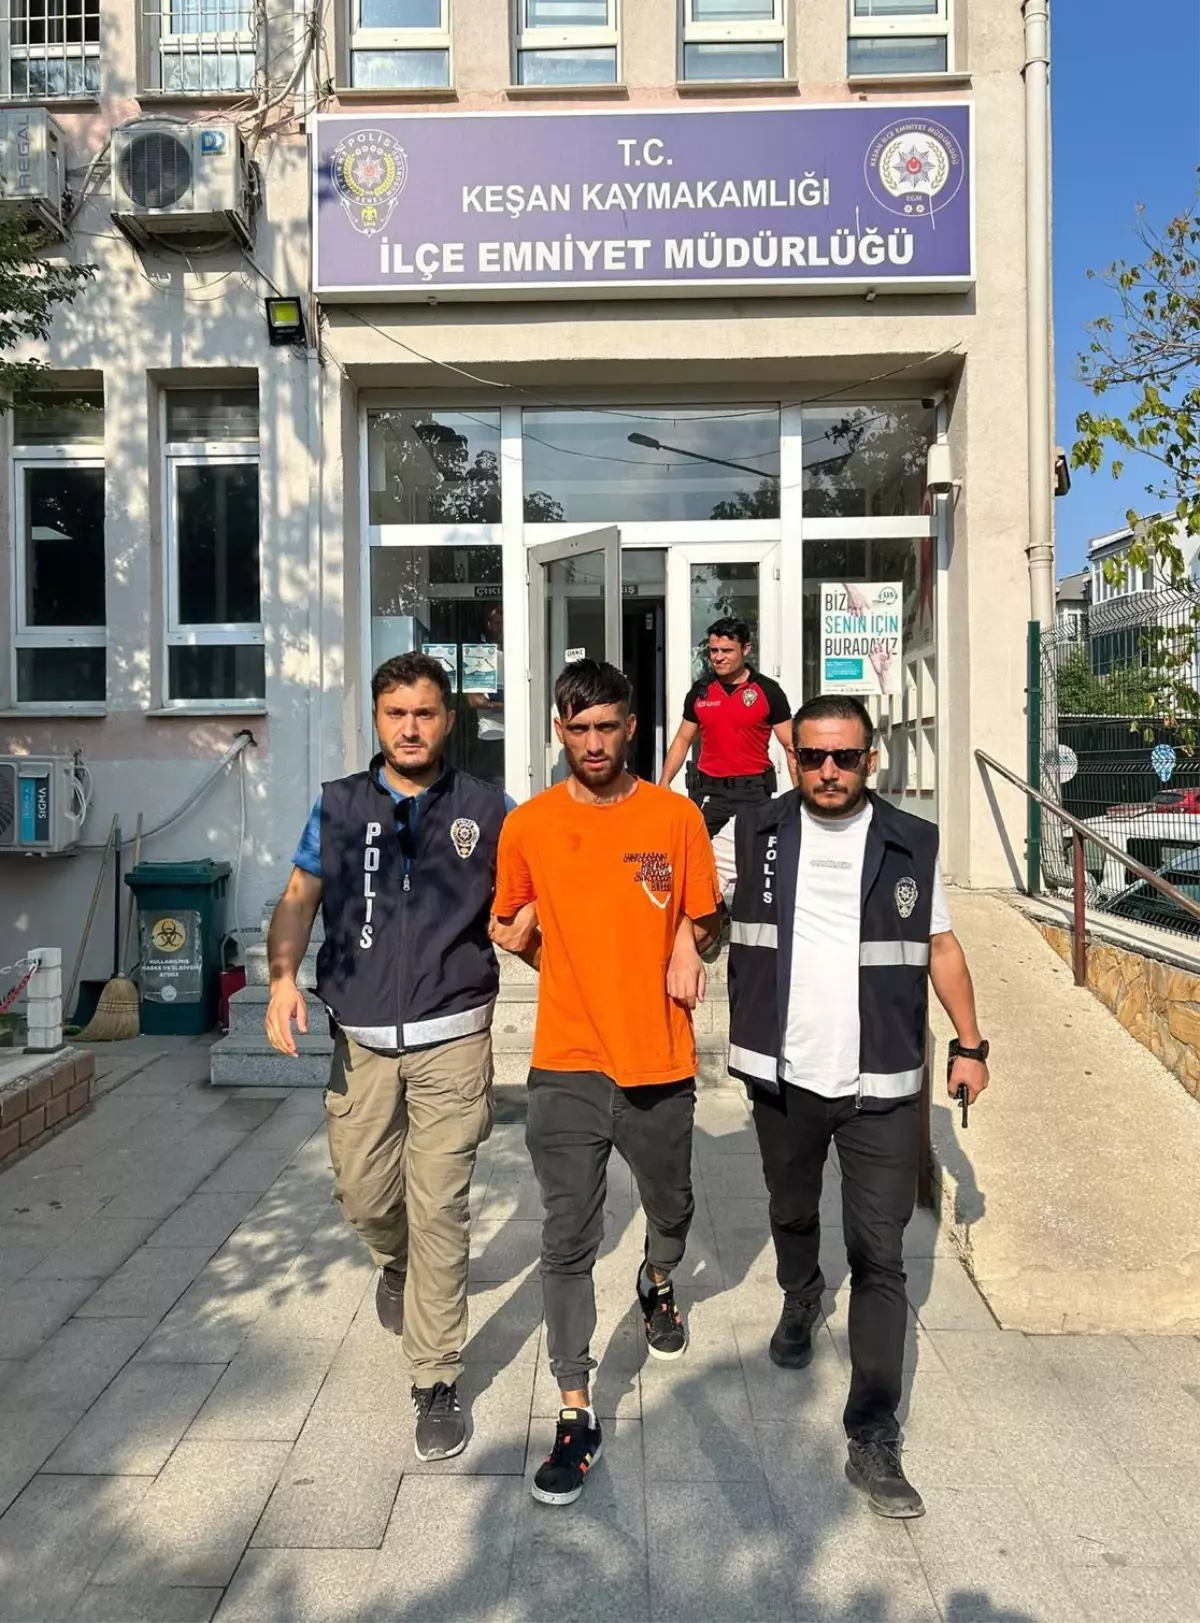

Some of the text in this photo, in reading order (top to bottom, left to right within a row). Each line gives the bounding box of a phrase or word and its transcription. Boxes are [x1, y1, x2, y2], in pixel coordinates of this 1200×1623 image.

[17, 114, 30, 188] REGAL
[617, 139, 673, 167] T.C.
[462, 171, 830, 219] KEŞAN KAYMAKAMLIĞI
[380, 227, 914, 281] İLÇE EMNİYET MÜDÜRLÜĞÜ
[476, 587, 502, 597] ÇIKI
[825, 589, 847, 612] BİZ
[871, 612, 898, 636] İÇİN
[38, 787, 48, 819] SIGMA
